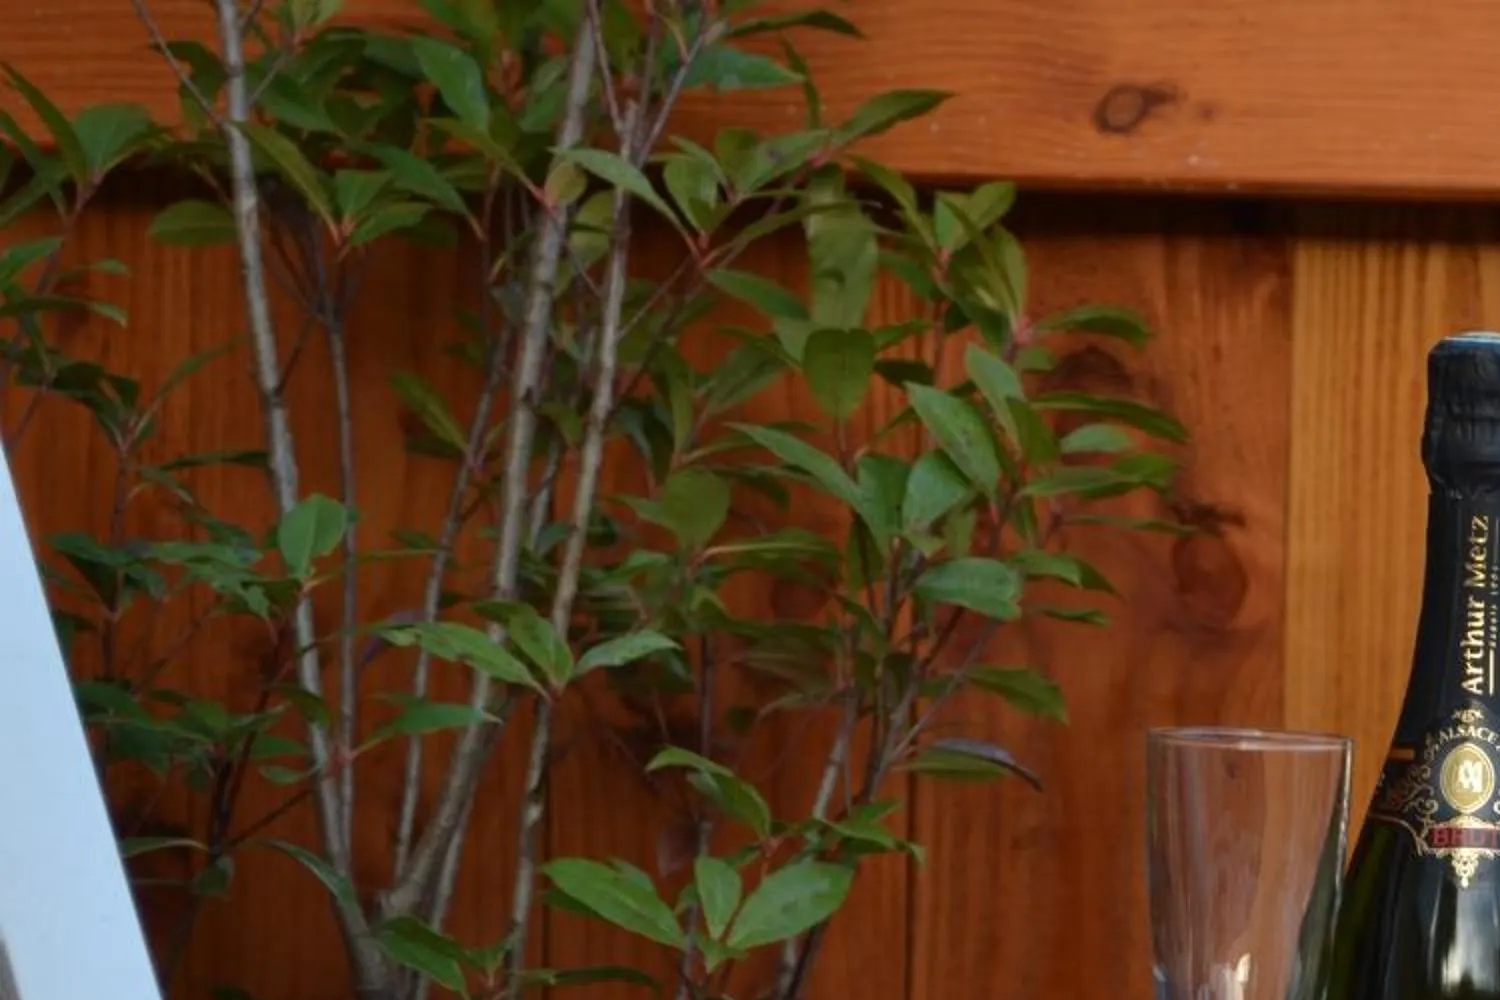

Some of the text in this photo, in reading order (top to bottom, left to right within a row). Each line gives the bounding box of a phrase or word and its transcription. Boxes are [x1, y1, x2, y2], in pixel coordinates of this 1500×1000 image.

[1459, 513, 1490, 696] Arthur Metz
[1439, 726, 1497, 745] ALSACE
[1433, 829, 1498, 848] BRUT
